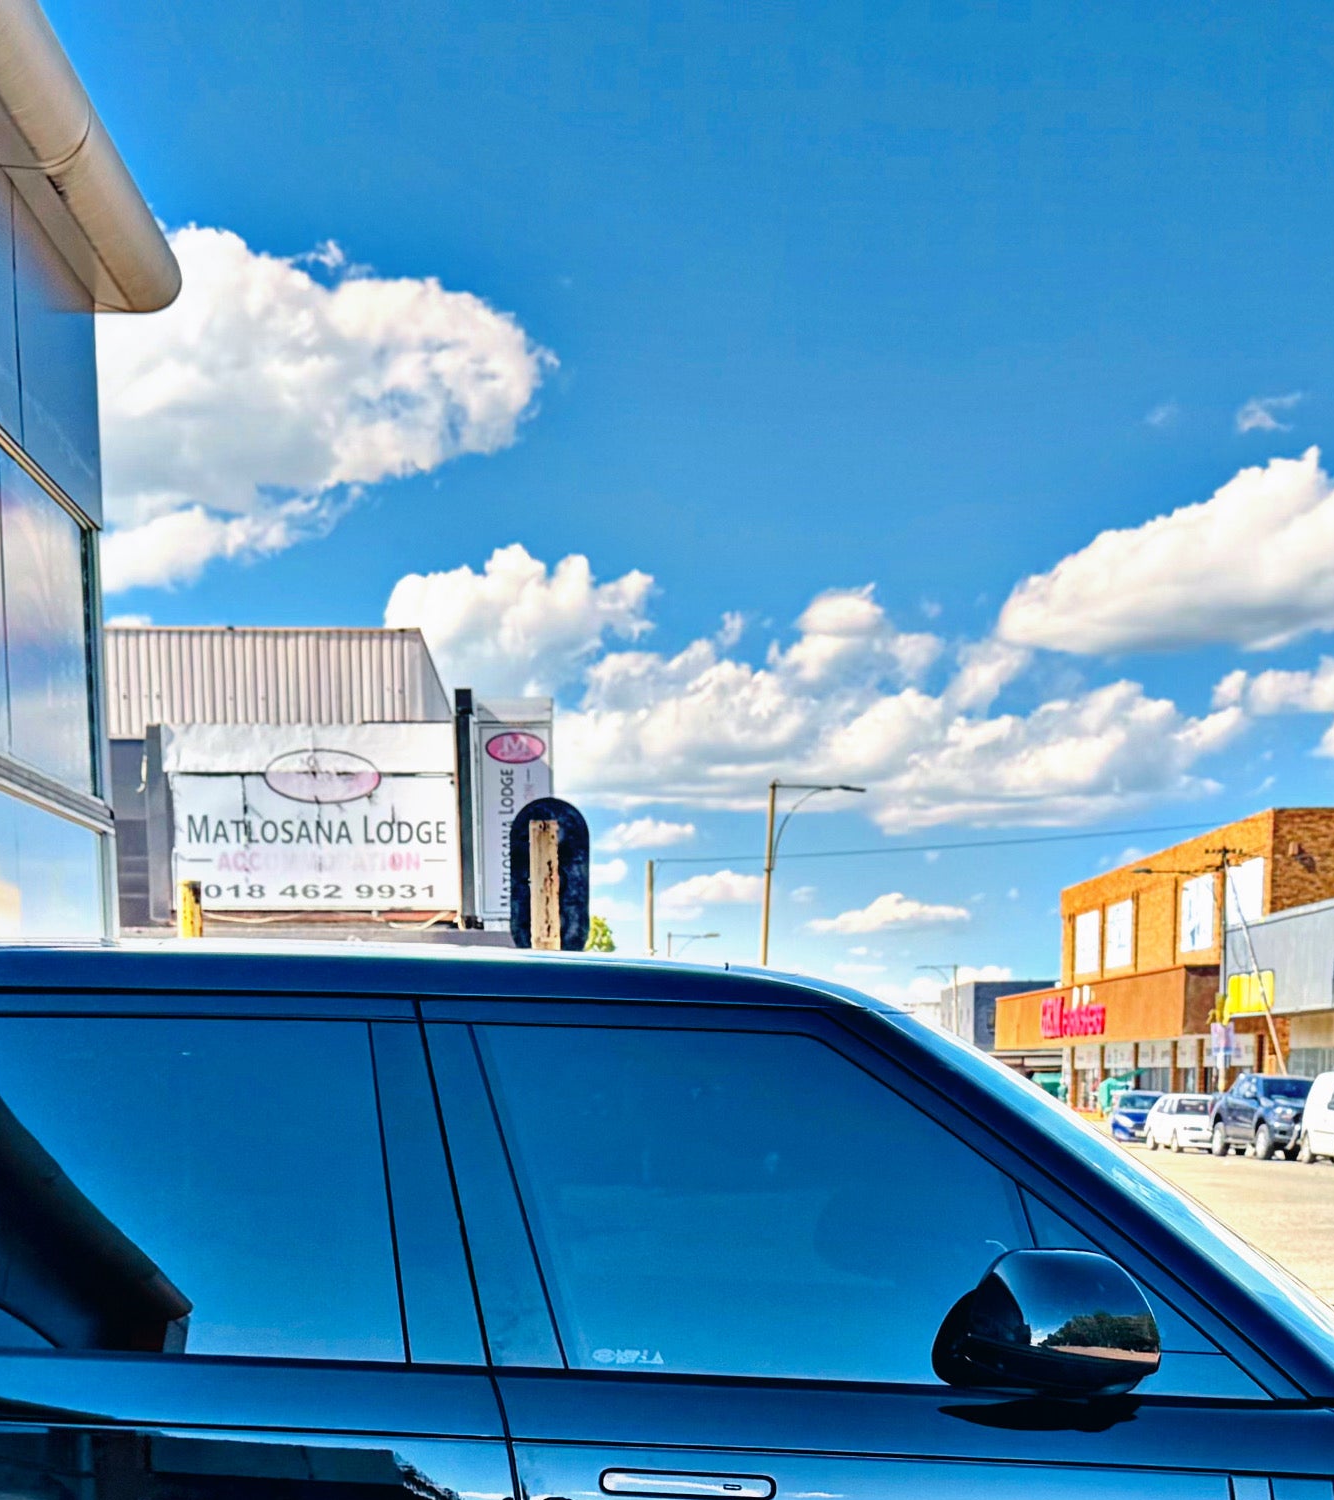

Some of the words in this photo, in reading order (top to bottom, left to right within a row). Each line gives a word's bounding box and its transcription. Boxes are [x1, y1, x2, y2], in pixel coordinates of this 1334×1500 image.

[499, 768, 514, 815] LODGE
[186, 814, 353, 844] MATLOSANA
[363, 814, 448, 844] LODGE
[217, 850, 421, 872] ACCOOATION
[204, 884, 266, 900] 018
[278, 884, 344, 900] 462
[355, 884, 436, 900] 9931
